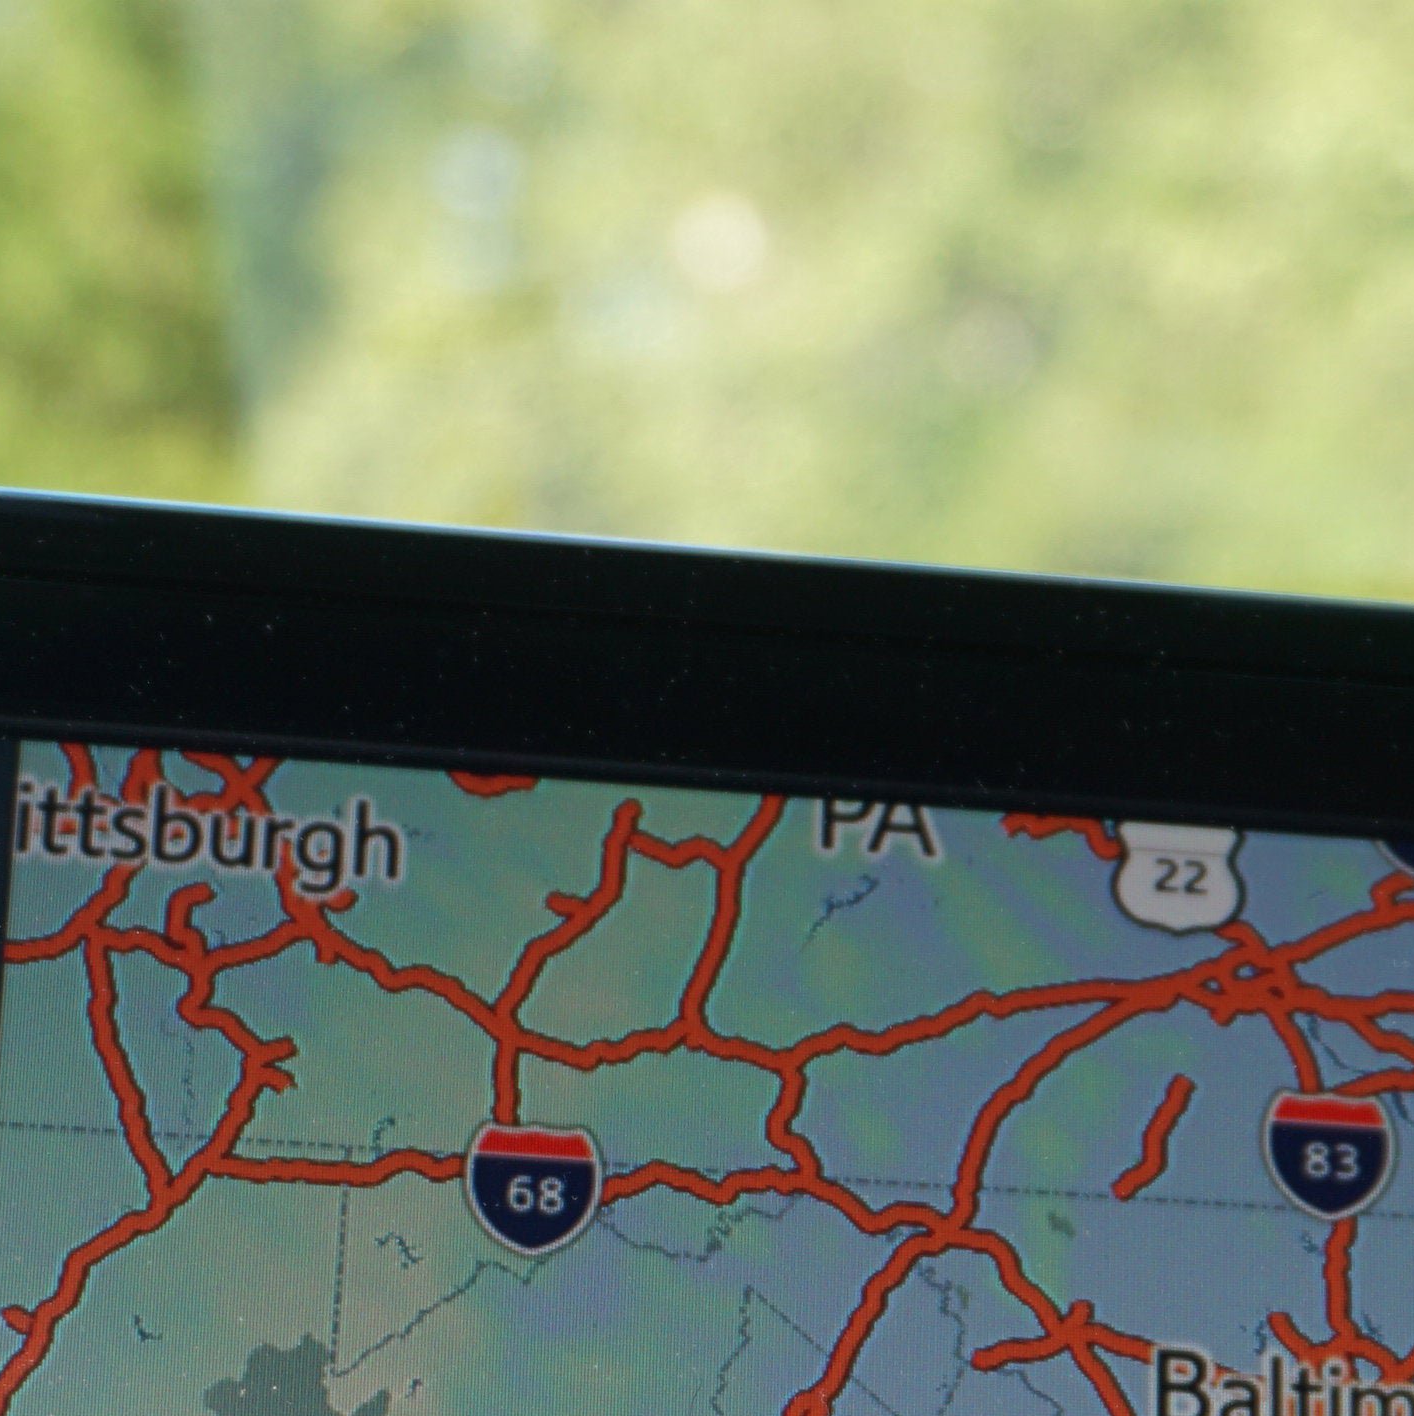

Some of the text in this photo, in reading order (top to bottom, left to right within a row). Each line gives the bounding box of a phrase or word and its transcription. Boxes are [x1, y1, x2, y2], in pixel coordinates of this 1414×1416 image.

[15, 778, 400, 893] ittsburgh
[821, 797, 937, 858] PA
[1153, 858, 1210, 895] 22
[1302, 1143, 1358, 1177] 83
[506, 1175, 565, 1214] 68
